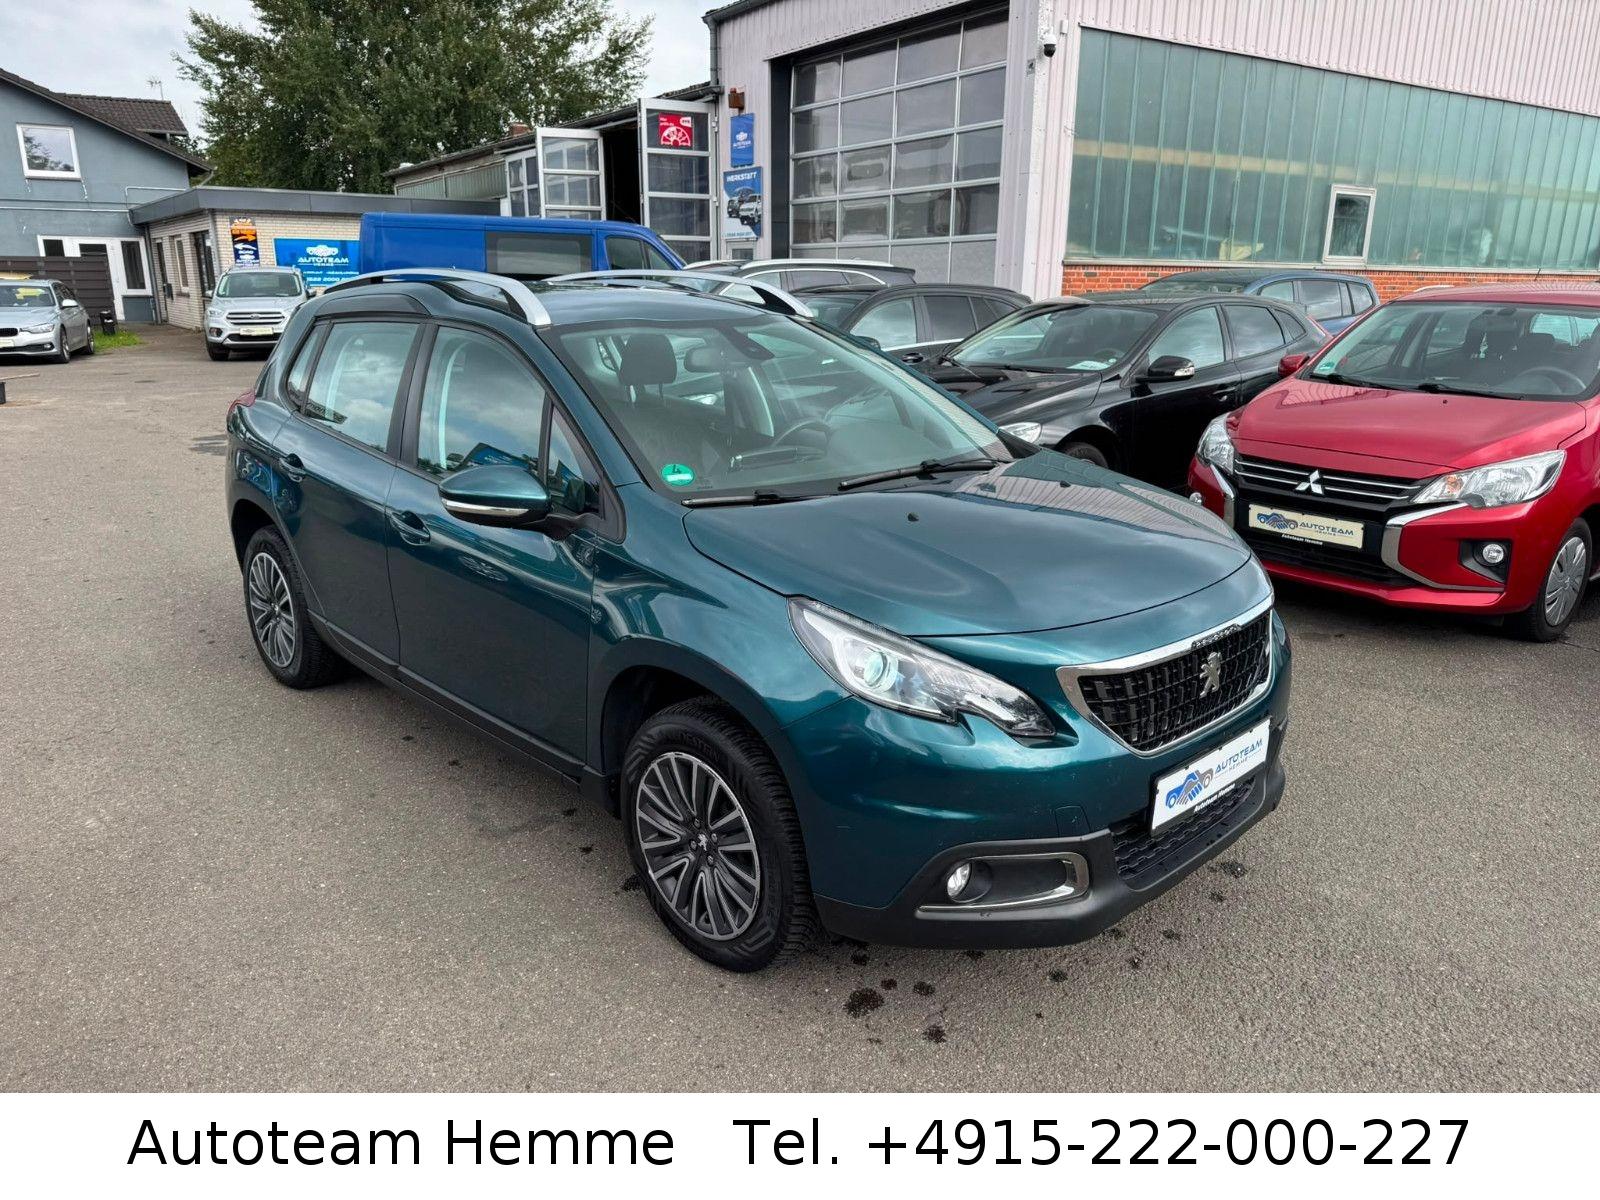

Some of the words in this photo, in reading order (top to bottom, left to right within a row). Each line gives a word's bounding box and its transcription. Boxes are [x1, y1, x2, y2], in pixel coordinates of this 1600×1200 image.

[727, 172, 757, 181] WERKSTATT
[1299, 521, 1354, 536] AUTOTEAM
[1215, 739, 1263, 774] AUTOTEAM
